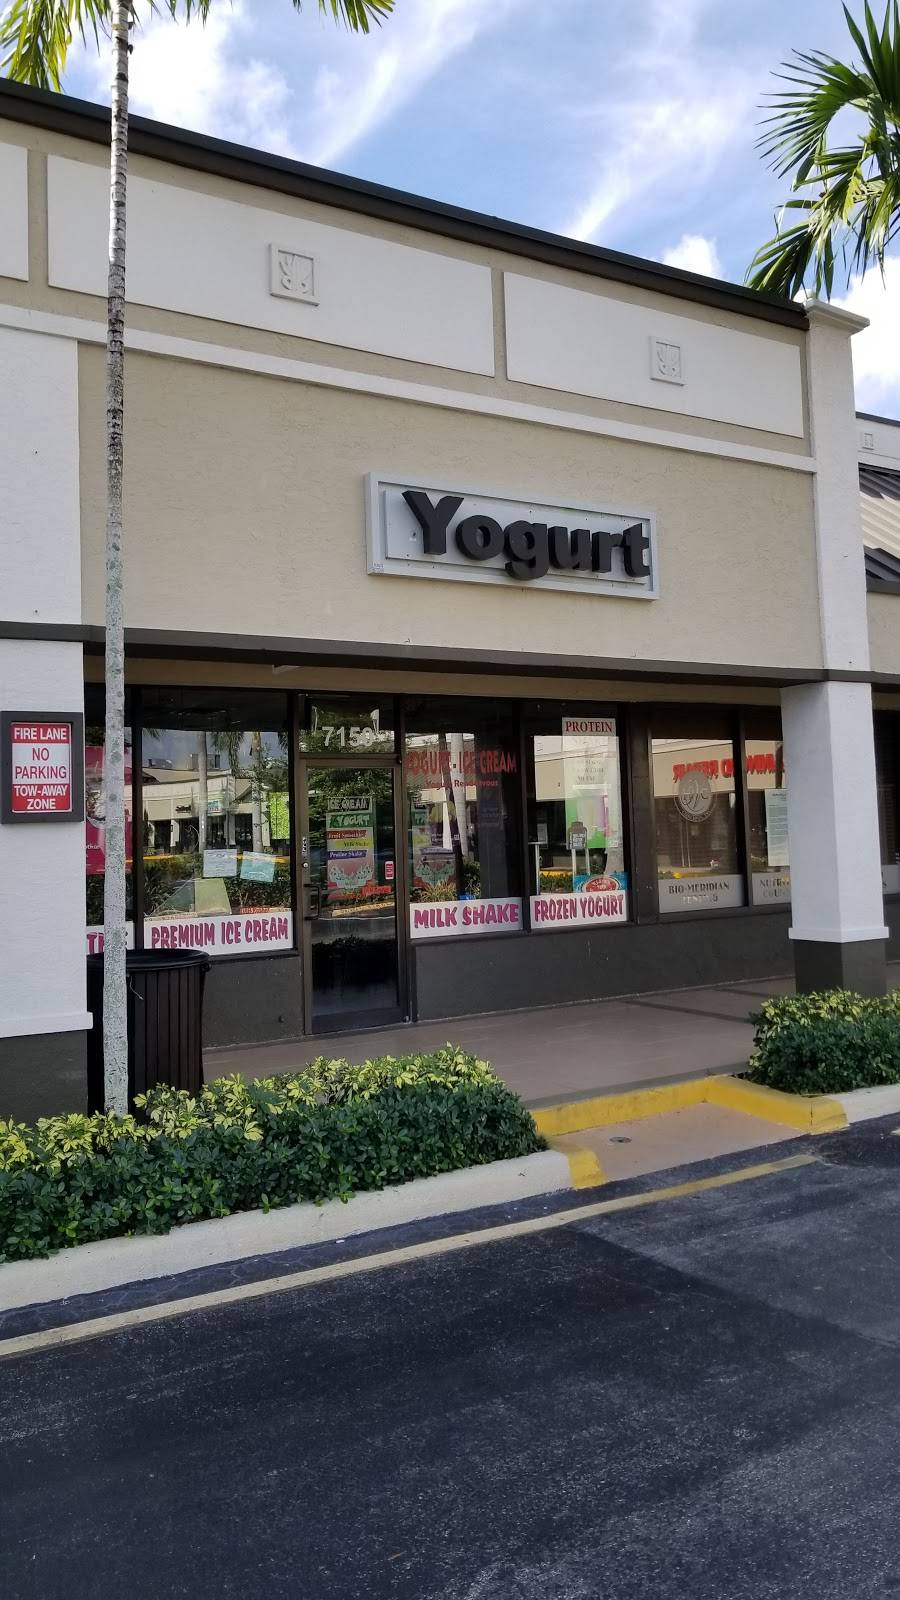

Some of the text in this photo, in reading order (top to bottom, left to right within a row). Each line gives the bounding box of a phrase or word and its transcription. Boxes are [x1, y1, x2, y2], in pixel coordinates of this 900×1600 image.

[401, 490, 650, 580] Yogurt
[14, 728, 67, 740] FIRE LANE
[565, 721, 613, 733] PROTEIN
[32, 747, 50, 761] NO
[15, 765, 67, 779] PARKING
[14, 785, 67, 797] TOW-AWAY
[26, 799, 56, 810] ZONE
[534, 894, 624, 922] FROZEN YOGURT
[414, 903, 519, 928] MILK SHAKE
[151, 917, 289, 948] PREMIUM ICE CREAM
